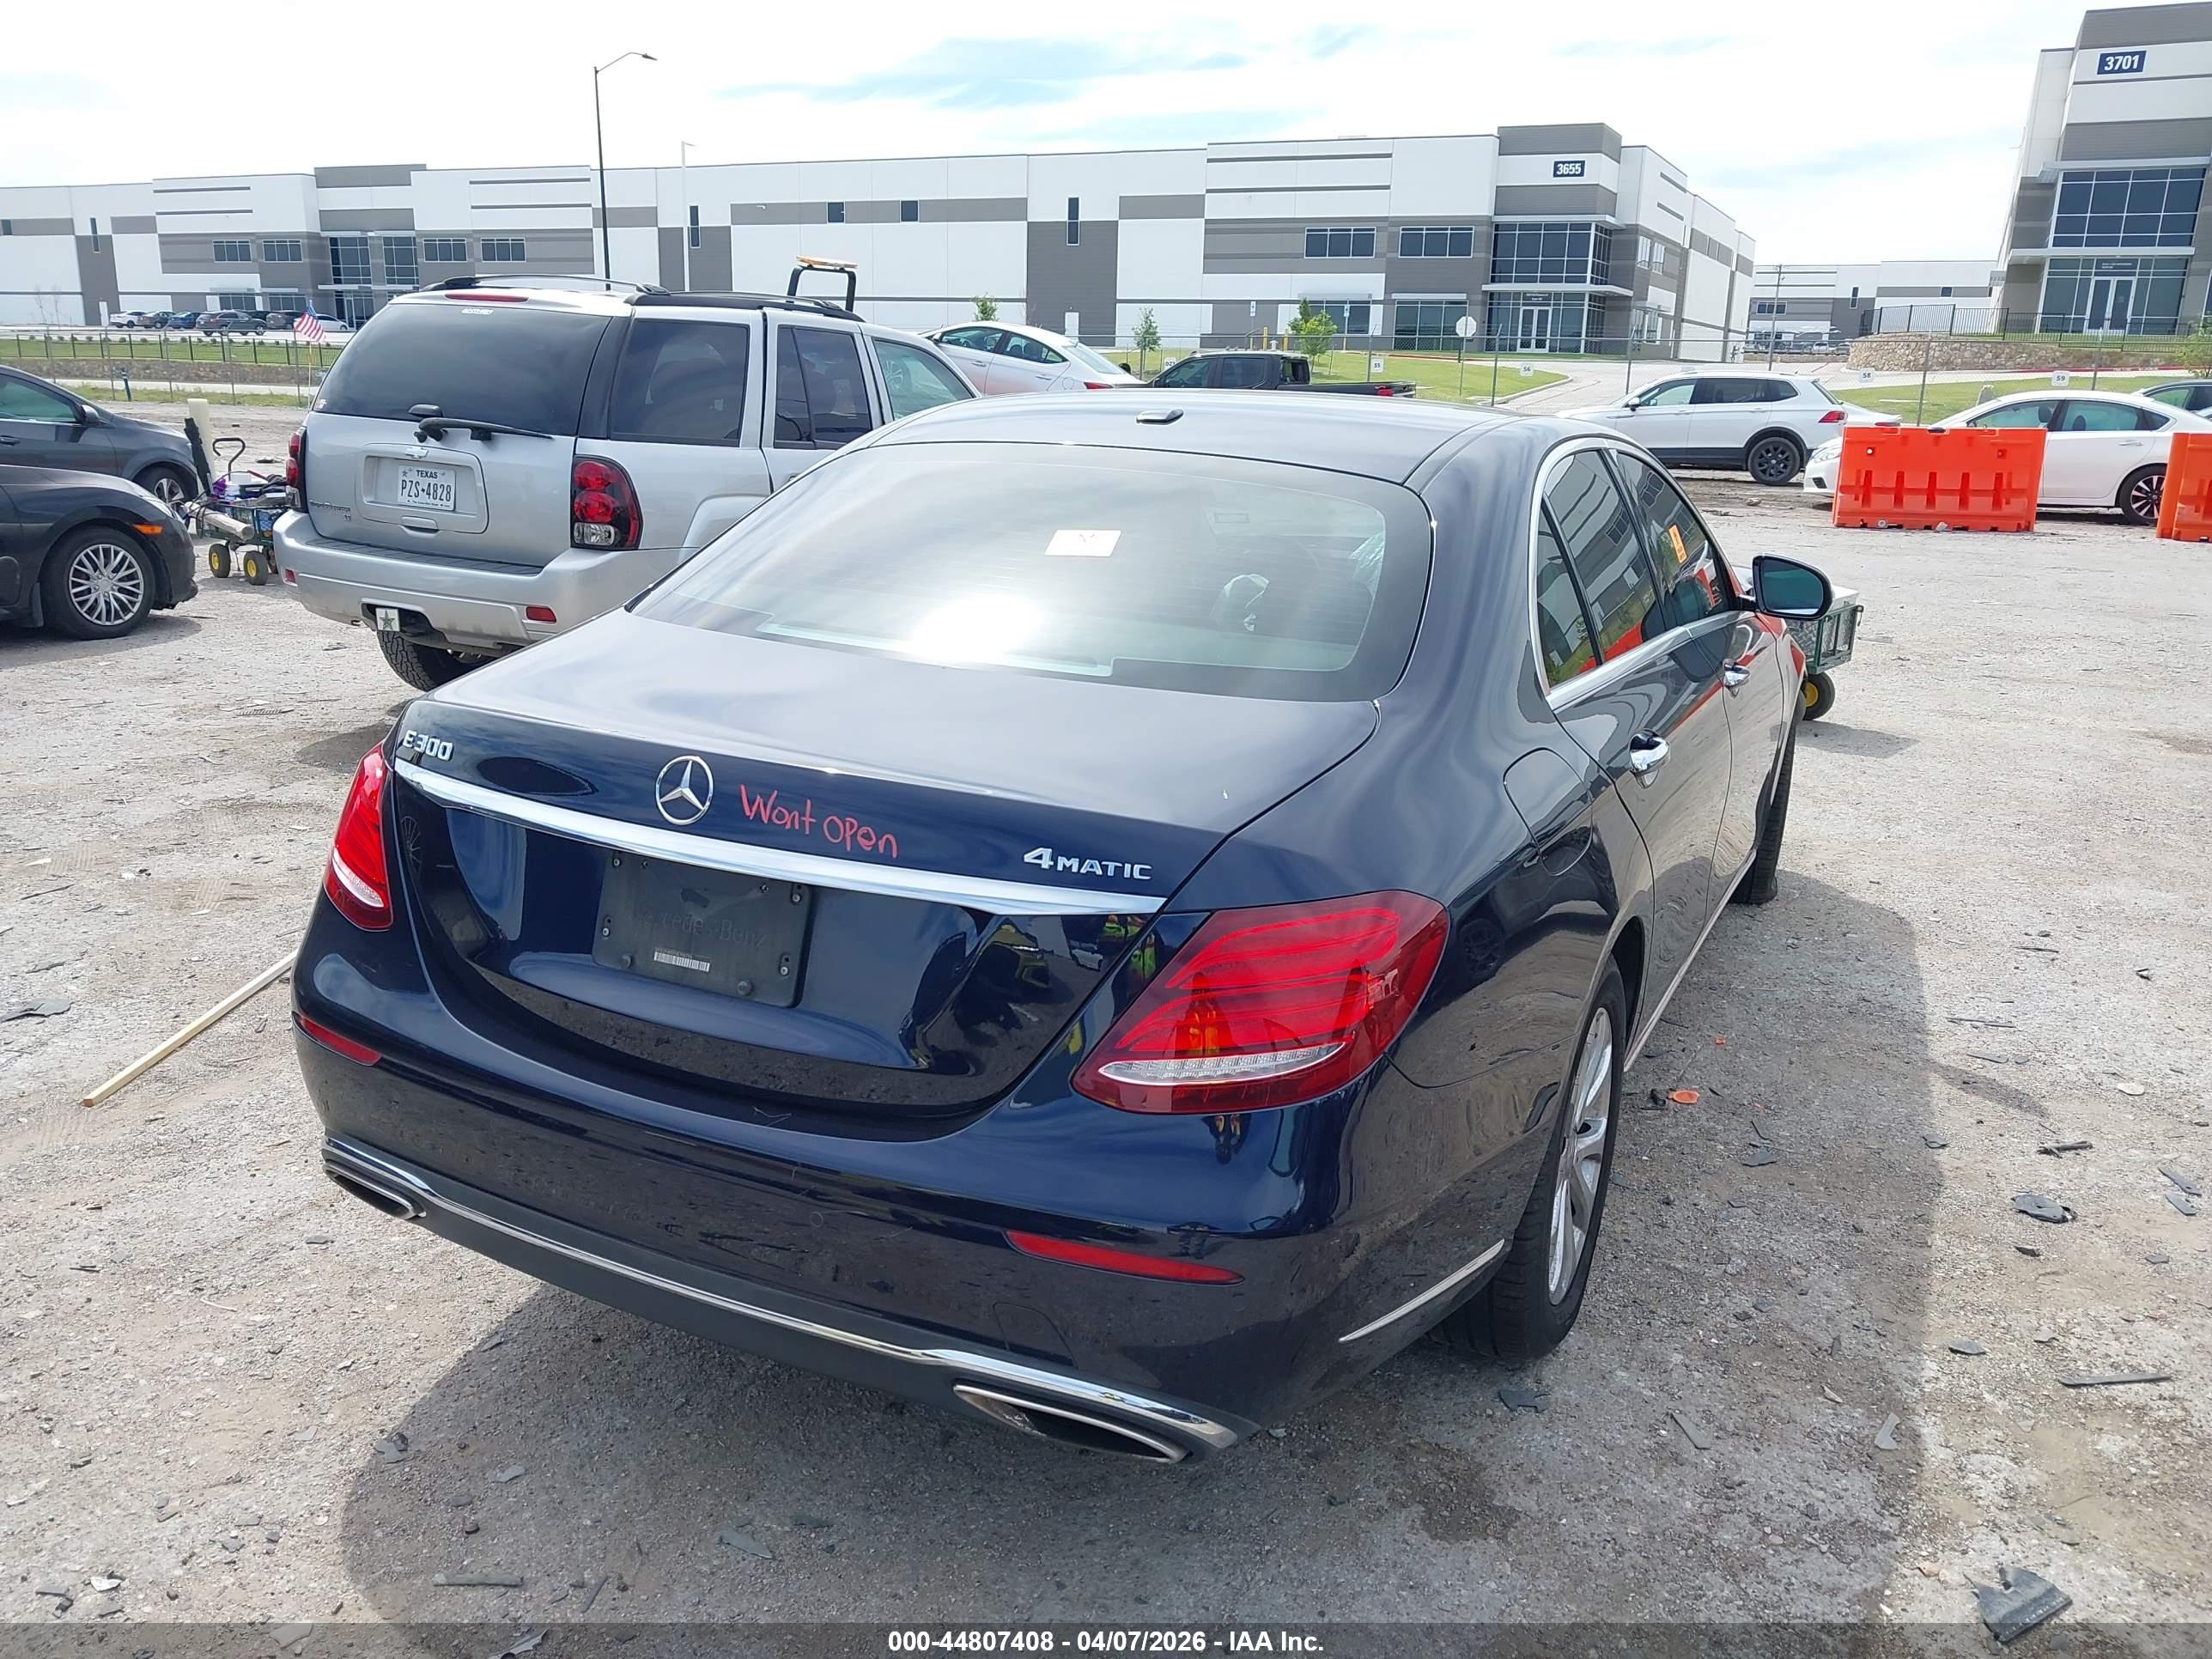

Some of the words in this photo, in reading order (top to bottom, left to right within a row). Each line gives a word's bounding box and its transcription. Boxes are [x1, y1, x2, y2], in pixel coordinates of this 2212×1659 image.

[2104, 54, 2140, 71] 3701
[1556, 162, 1582, 175] 3655
[416, 469, 439, 479] TEXAS
[402, 729, 454, 762] E300
[739, 783, 817, 836] Wont
[1023, 847, 1152, 880] 4MATIC
